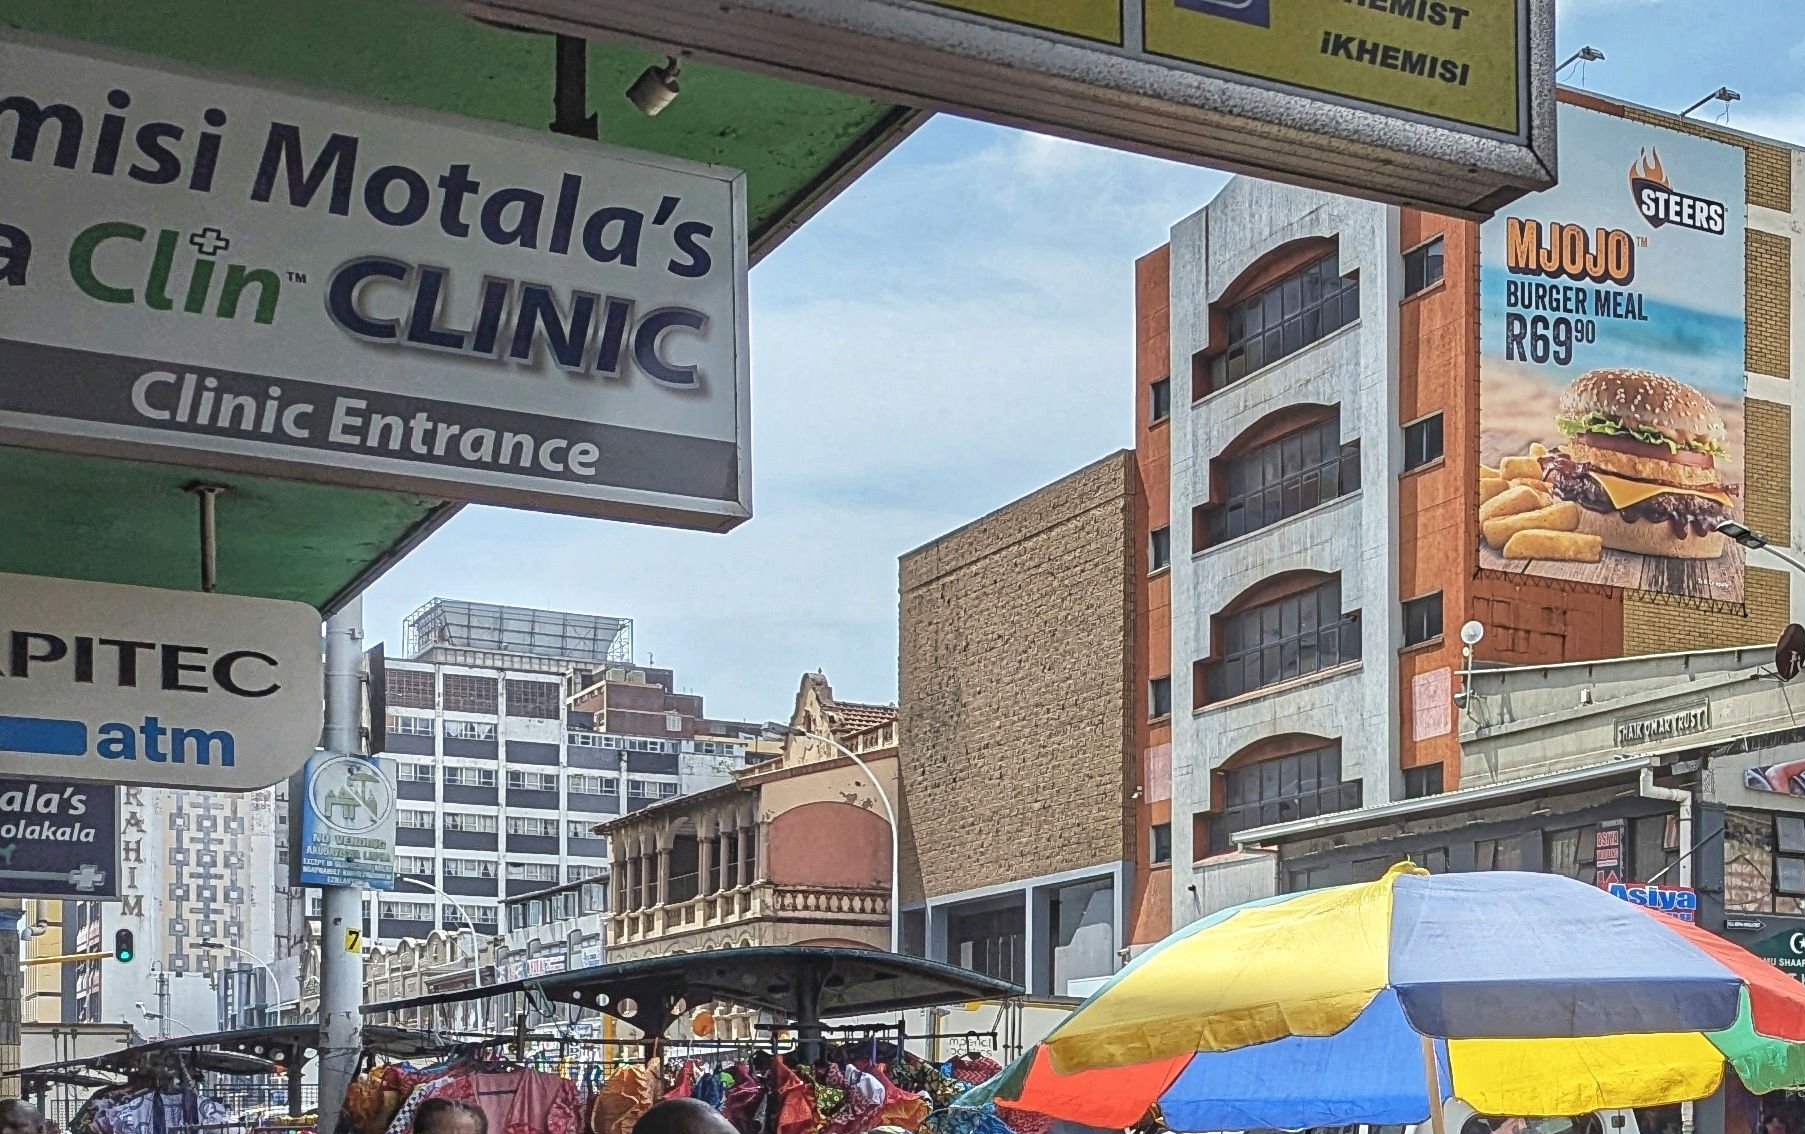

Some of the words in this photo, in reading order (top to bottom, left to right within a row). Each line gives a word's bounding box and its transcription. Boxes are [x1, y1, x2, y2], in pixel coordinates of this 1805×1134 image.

[1343, 0, 1470, 30] EMIST
[250, 121, 713, 278] Motala's
[1641, 188, 1724, 232] STEERS
[1507, 217, 1633, 284] MJOJO
[67, 221, 283, 324] Clin
[328, 256, 710, 388] CLINIC
[1506, 280, 1588, 316] BURGER
[1594, 289, 1648, 321] MEAL
[131, 370, 311, 439] Clinic
[329, 400, 601, 476] Entrance
[0, 630, 282, 698] PITEC
[96, 716, 235, 767] atm
[1672, 708, 1706, 735] TRUST
[0, 820, 96, 842] olakala
[347, 931, 359, 950] 7
